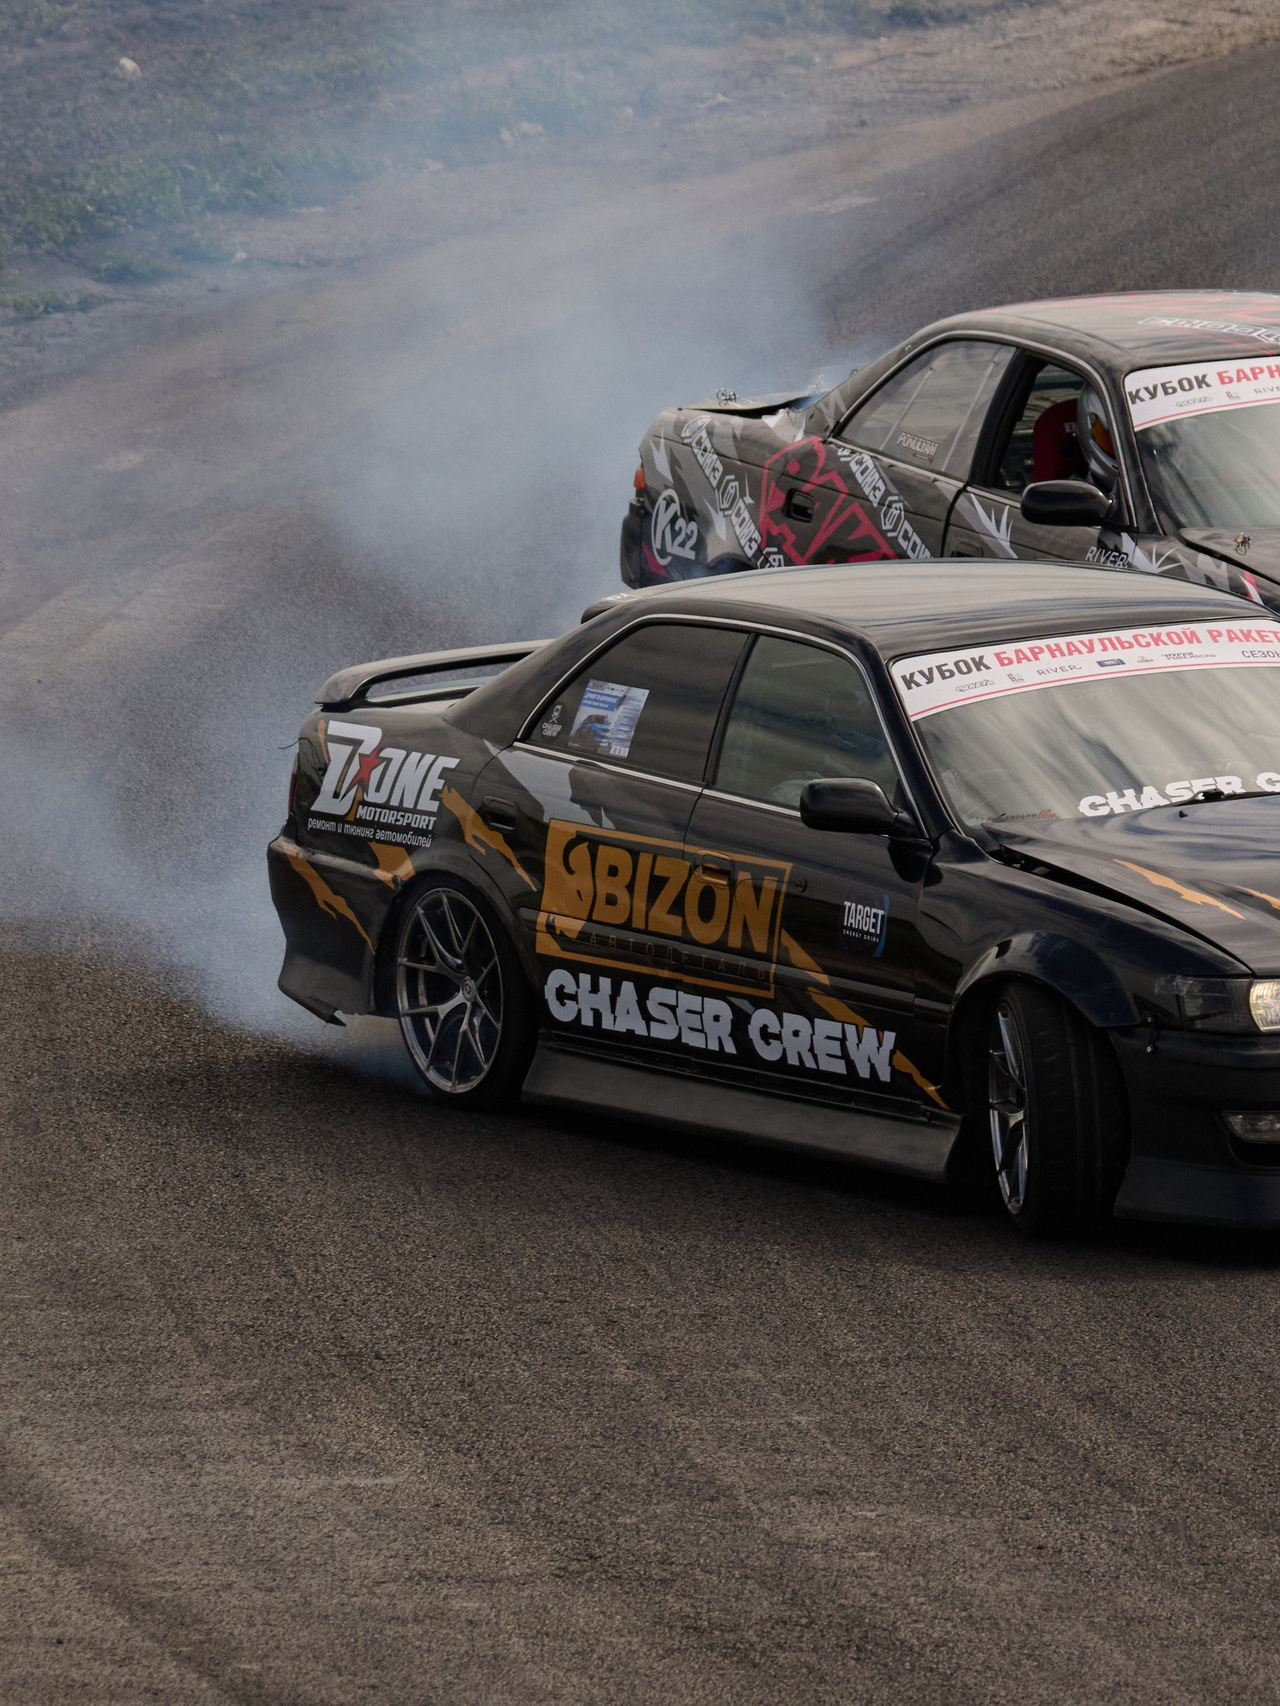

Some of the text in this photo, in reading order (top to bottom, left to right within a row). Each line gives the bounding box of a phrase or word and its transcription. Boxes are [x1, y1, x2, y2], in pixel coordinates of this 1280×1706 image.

[1127, 374, 1213, 405] КУБОК
[900, 655, 992, 690] КУБОК
[993, 627, 1203, 667] БАРНАУЛЬСКОЙ
[1036, 664, 1082, 676] RIVER
[1078, 774, 1245, 818] CHASER
[307, 817, 337, 832] ремонт
[343, 825, 374, 837] тюнинг
[375, 828, 432, 848] автомобилей
[356, 804, 437, 830] MOTORSPORT
[592, 844, 779, 954] BIZON
[843, 900, 885, 935] TARGET
[544, 968, 896, 1083] CHASER CREW
